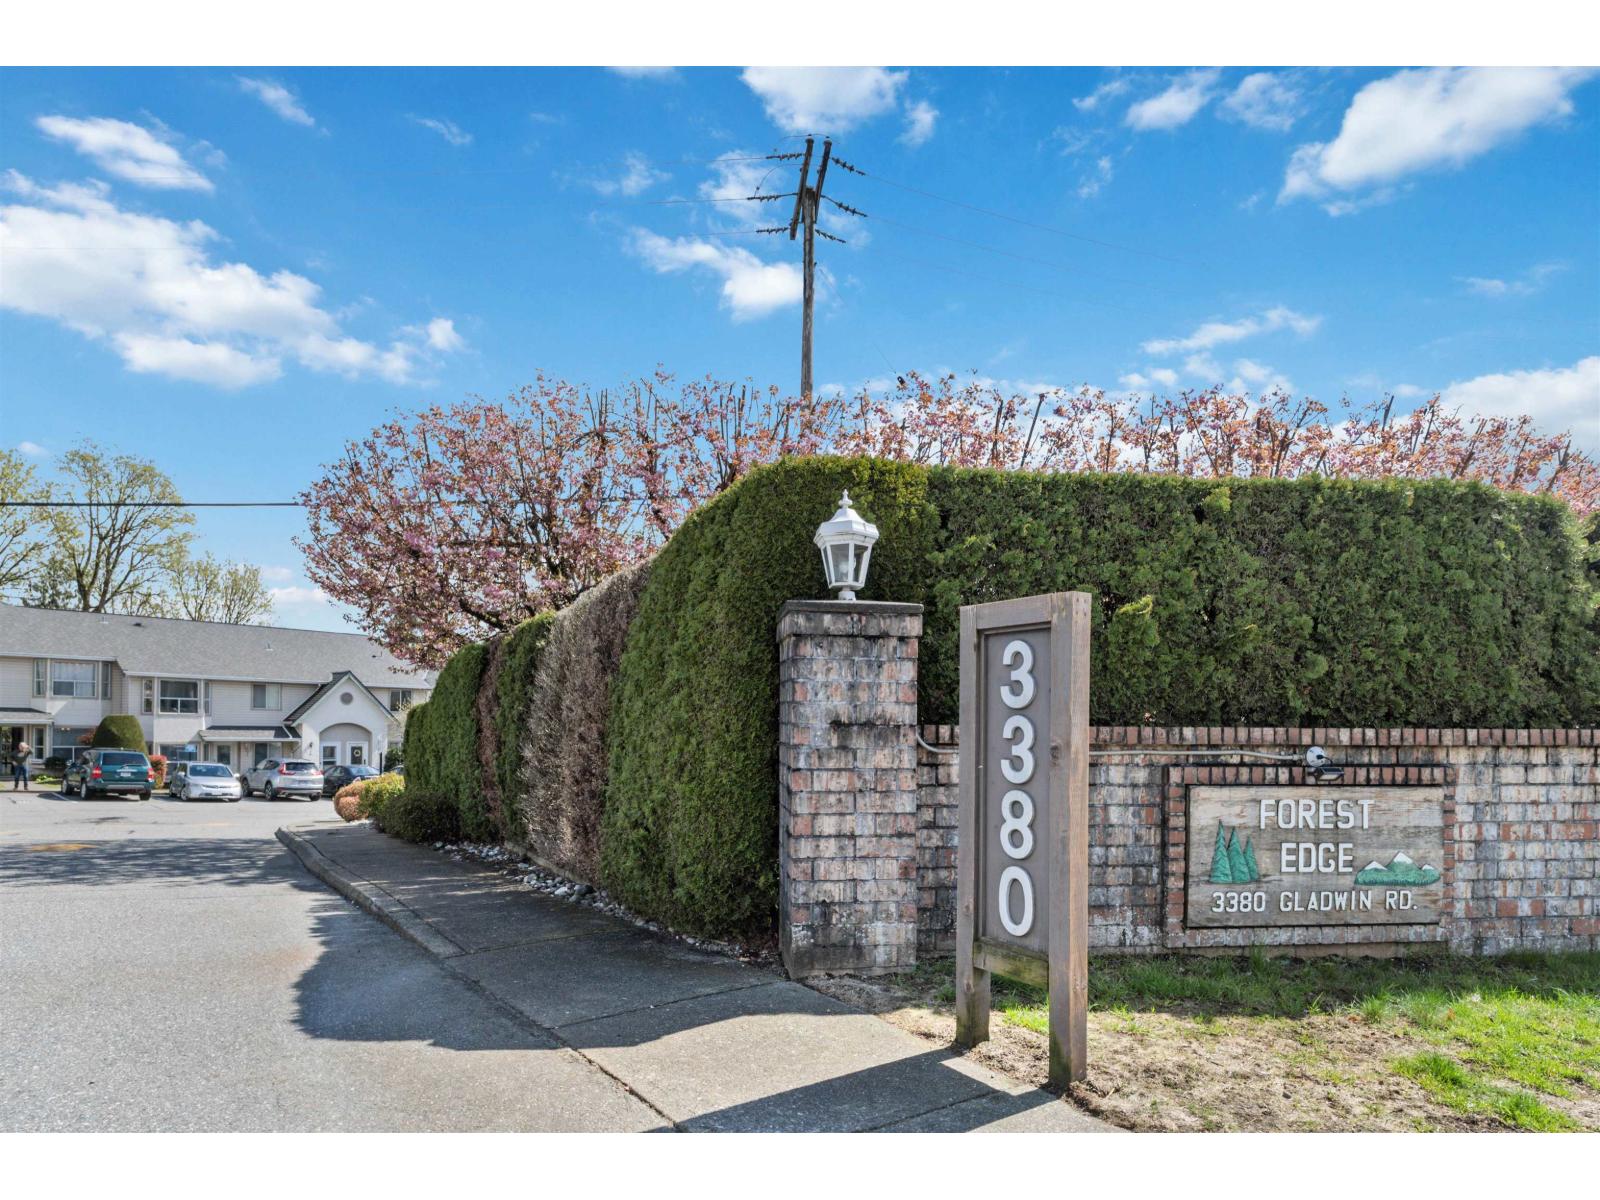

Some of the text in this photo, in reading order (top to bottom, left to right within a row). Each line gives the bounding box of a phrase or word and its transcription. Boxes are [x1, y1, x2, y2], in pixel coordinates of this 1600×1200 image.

[999, 639, 1035, 937] 3380
[1260, 799, 1375, 830] FOREST
[1280, 842, 1353, 873] EDGE
[1211, 890, 1418, 913] 3380 GLADWIN RD.
